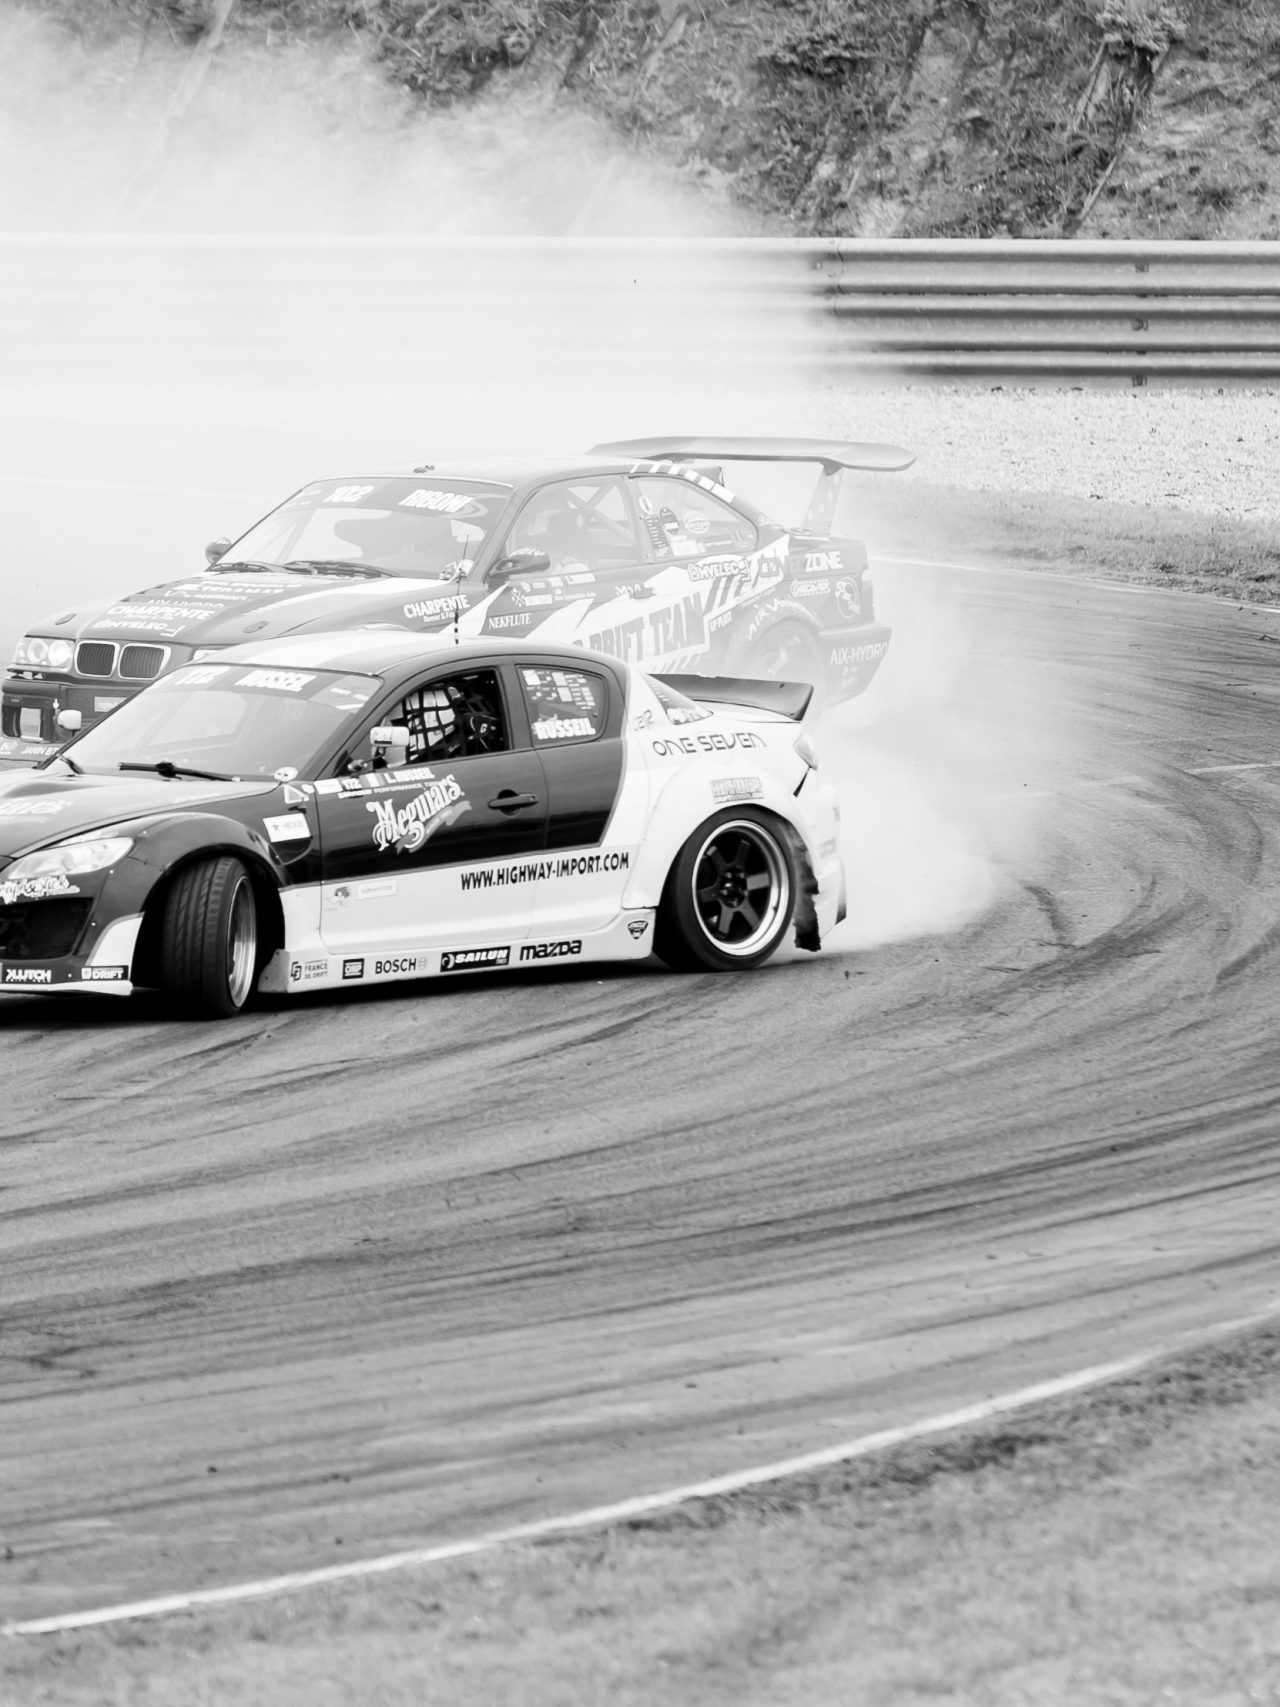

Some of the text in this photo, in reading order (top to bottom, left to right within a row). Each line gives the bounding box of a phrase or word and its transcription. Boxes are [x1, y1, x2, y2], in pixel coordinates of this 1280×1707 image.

[805, 551, 844, 573] ZONE
[108, 605, 216, 620] CHARPENTE
[404, 595, 470, 619] CHARPENTE
[649, 591, 706, 657] TEAM
[535, 718, 597, 740] RUSSEIL
[461, 852, 629, 891] WWW.HIGHWAY-IMPORT.COM
[375, 958, 417, 975] BOSCH
[455, 949, 509, 964] SAILUN
